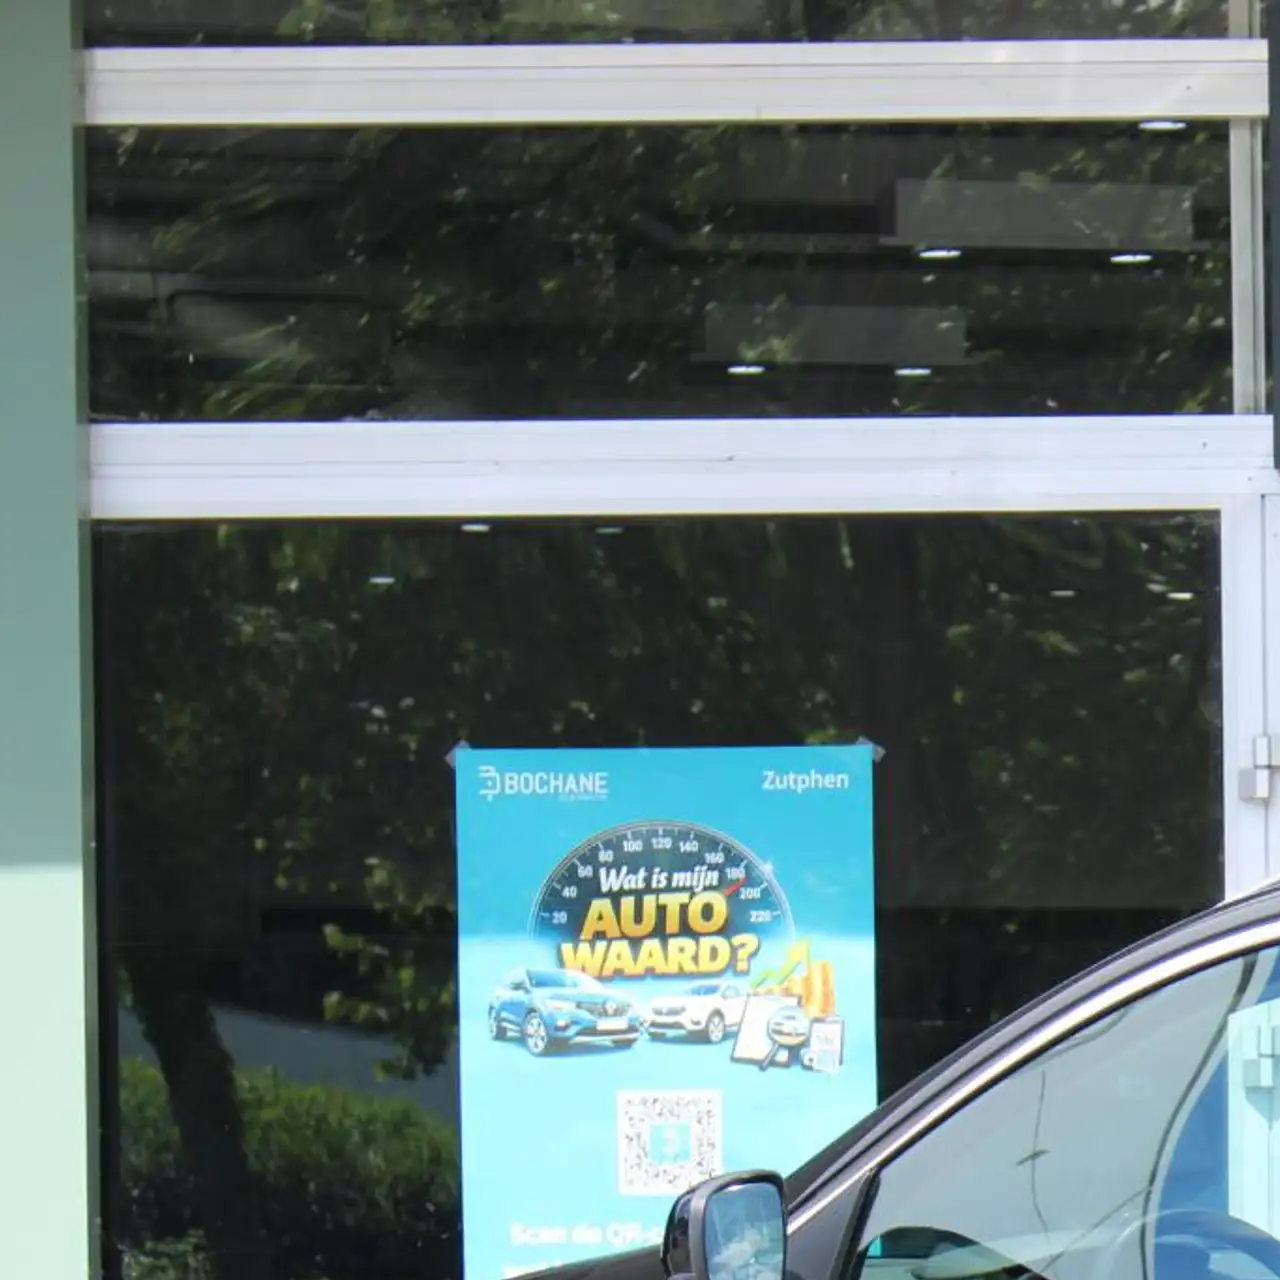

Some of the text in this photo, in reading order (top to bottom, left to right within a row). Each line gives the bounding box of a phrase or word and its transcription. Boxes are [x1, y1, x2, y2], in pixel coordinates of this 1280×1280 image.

[504, 771, 609, 795] BOCHANE
[761, 769, 850, 795] Zutphen
[622, 840, 643, 852] 100
[599, 865, 720, 892] Wat is mijn
[579, 891, 730, 941] AUTO
[560, 934, 759, 978] WAARD?
[606, 1221, 664, 1250] QR-c
